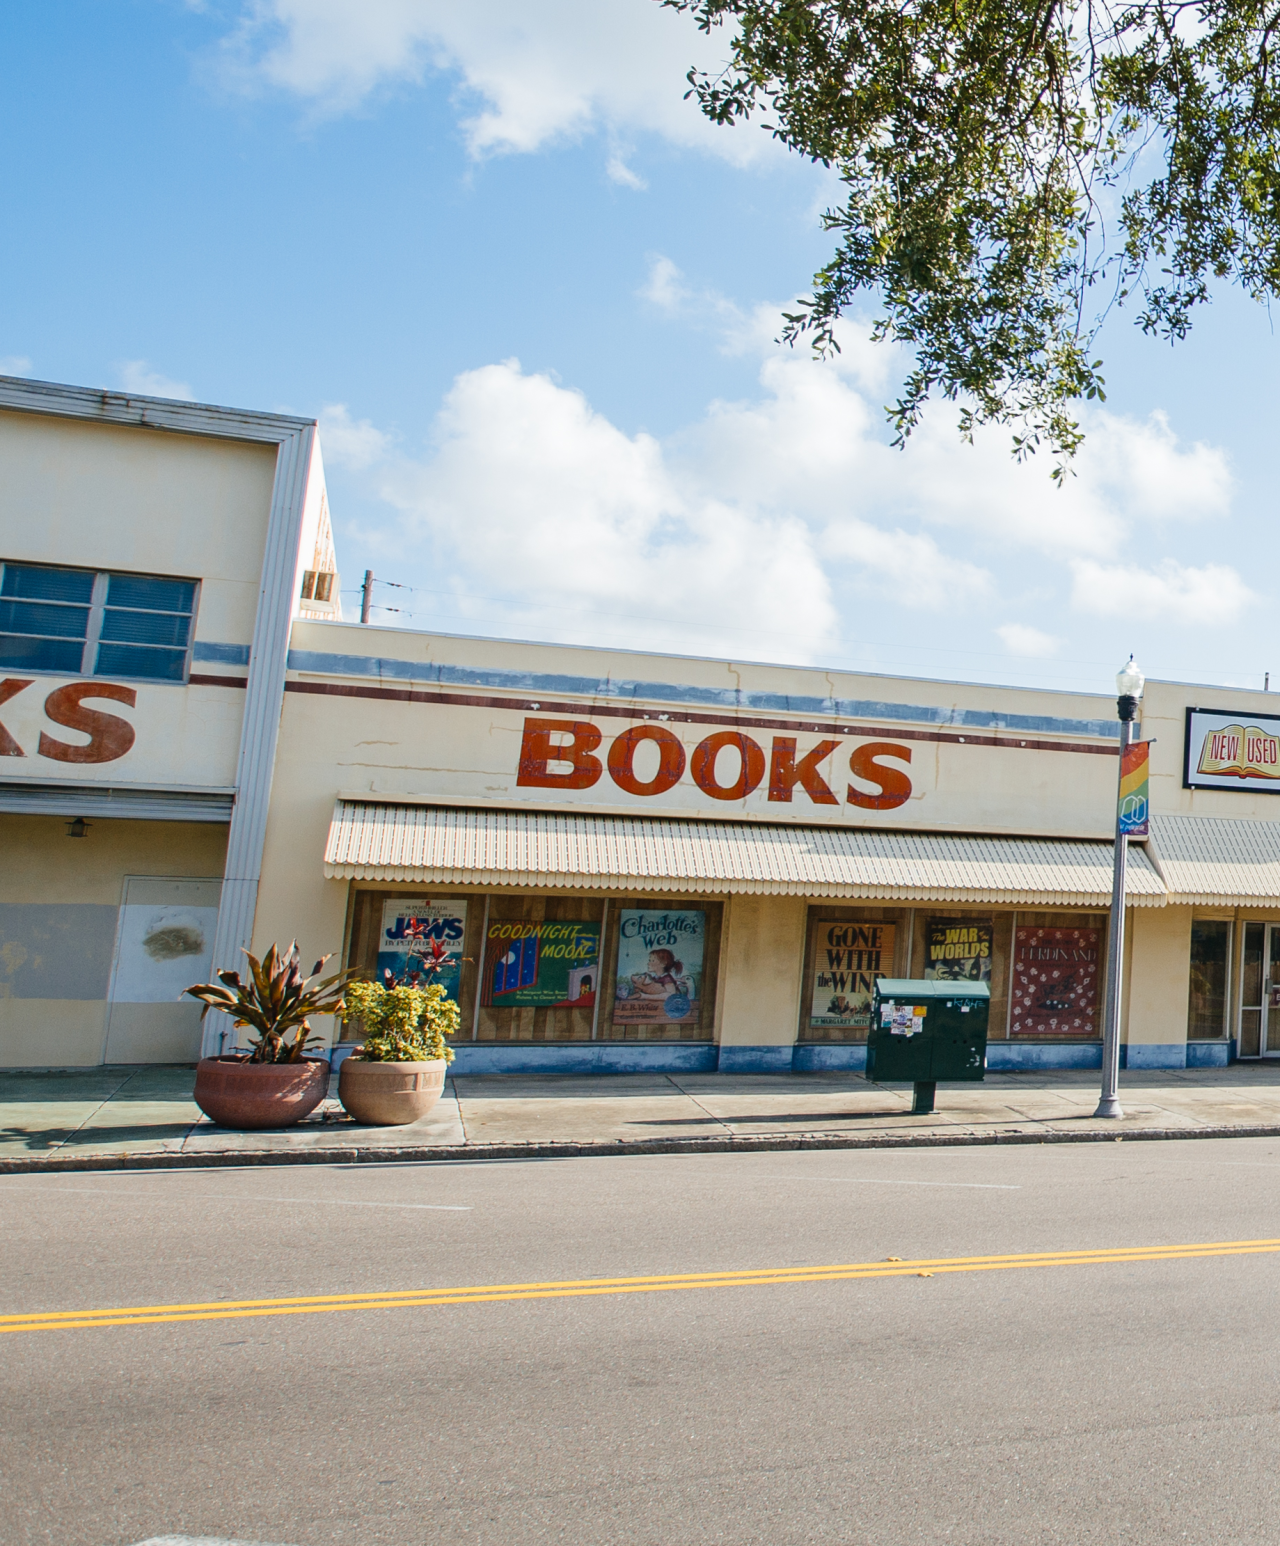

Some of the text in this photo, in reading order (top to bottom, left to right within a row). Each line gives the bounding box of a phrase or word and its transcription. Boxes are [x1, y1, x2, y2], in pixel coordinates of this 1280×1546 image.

[1209, 734, 1240, 761] NEW
[1247, 737, 1277, 764] USED
[516, 716, 913, 811] BOOKS
[385, 917, 464, 940] JAWS
[488, 924, 583, 939] GOODNIGHT
[620, 914, 699, 938] Charlotte's
[931, 933, 945, 941] The
[945, 927, 978, 943] WAR
[642, 930, 678, 949] Web
[827, 925, 884, 948] GONE
[540, 944, 589, 959] MOON
[825, 948, 882, 970] WITH
[930, 941, 990, 960] WORLDS
[1021, 946, 1097, 962] FERDINAND
[817, 972, 833, 987] the
